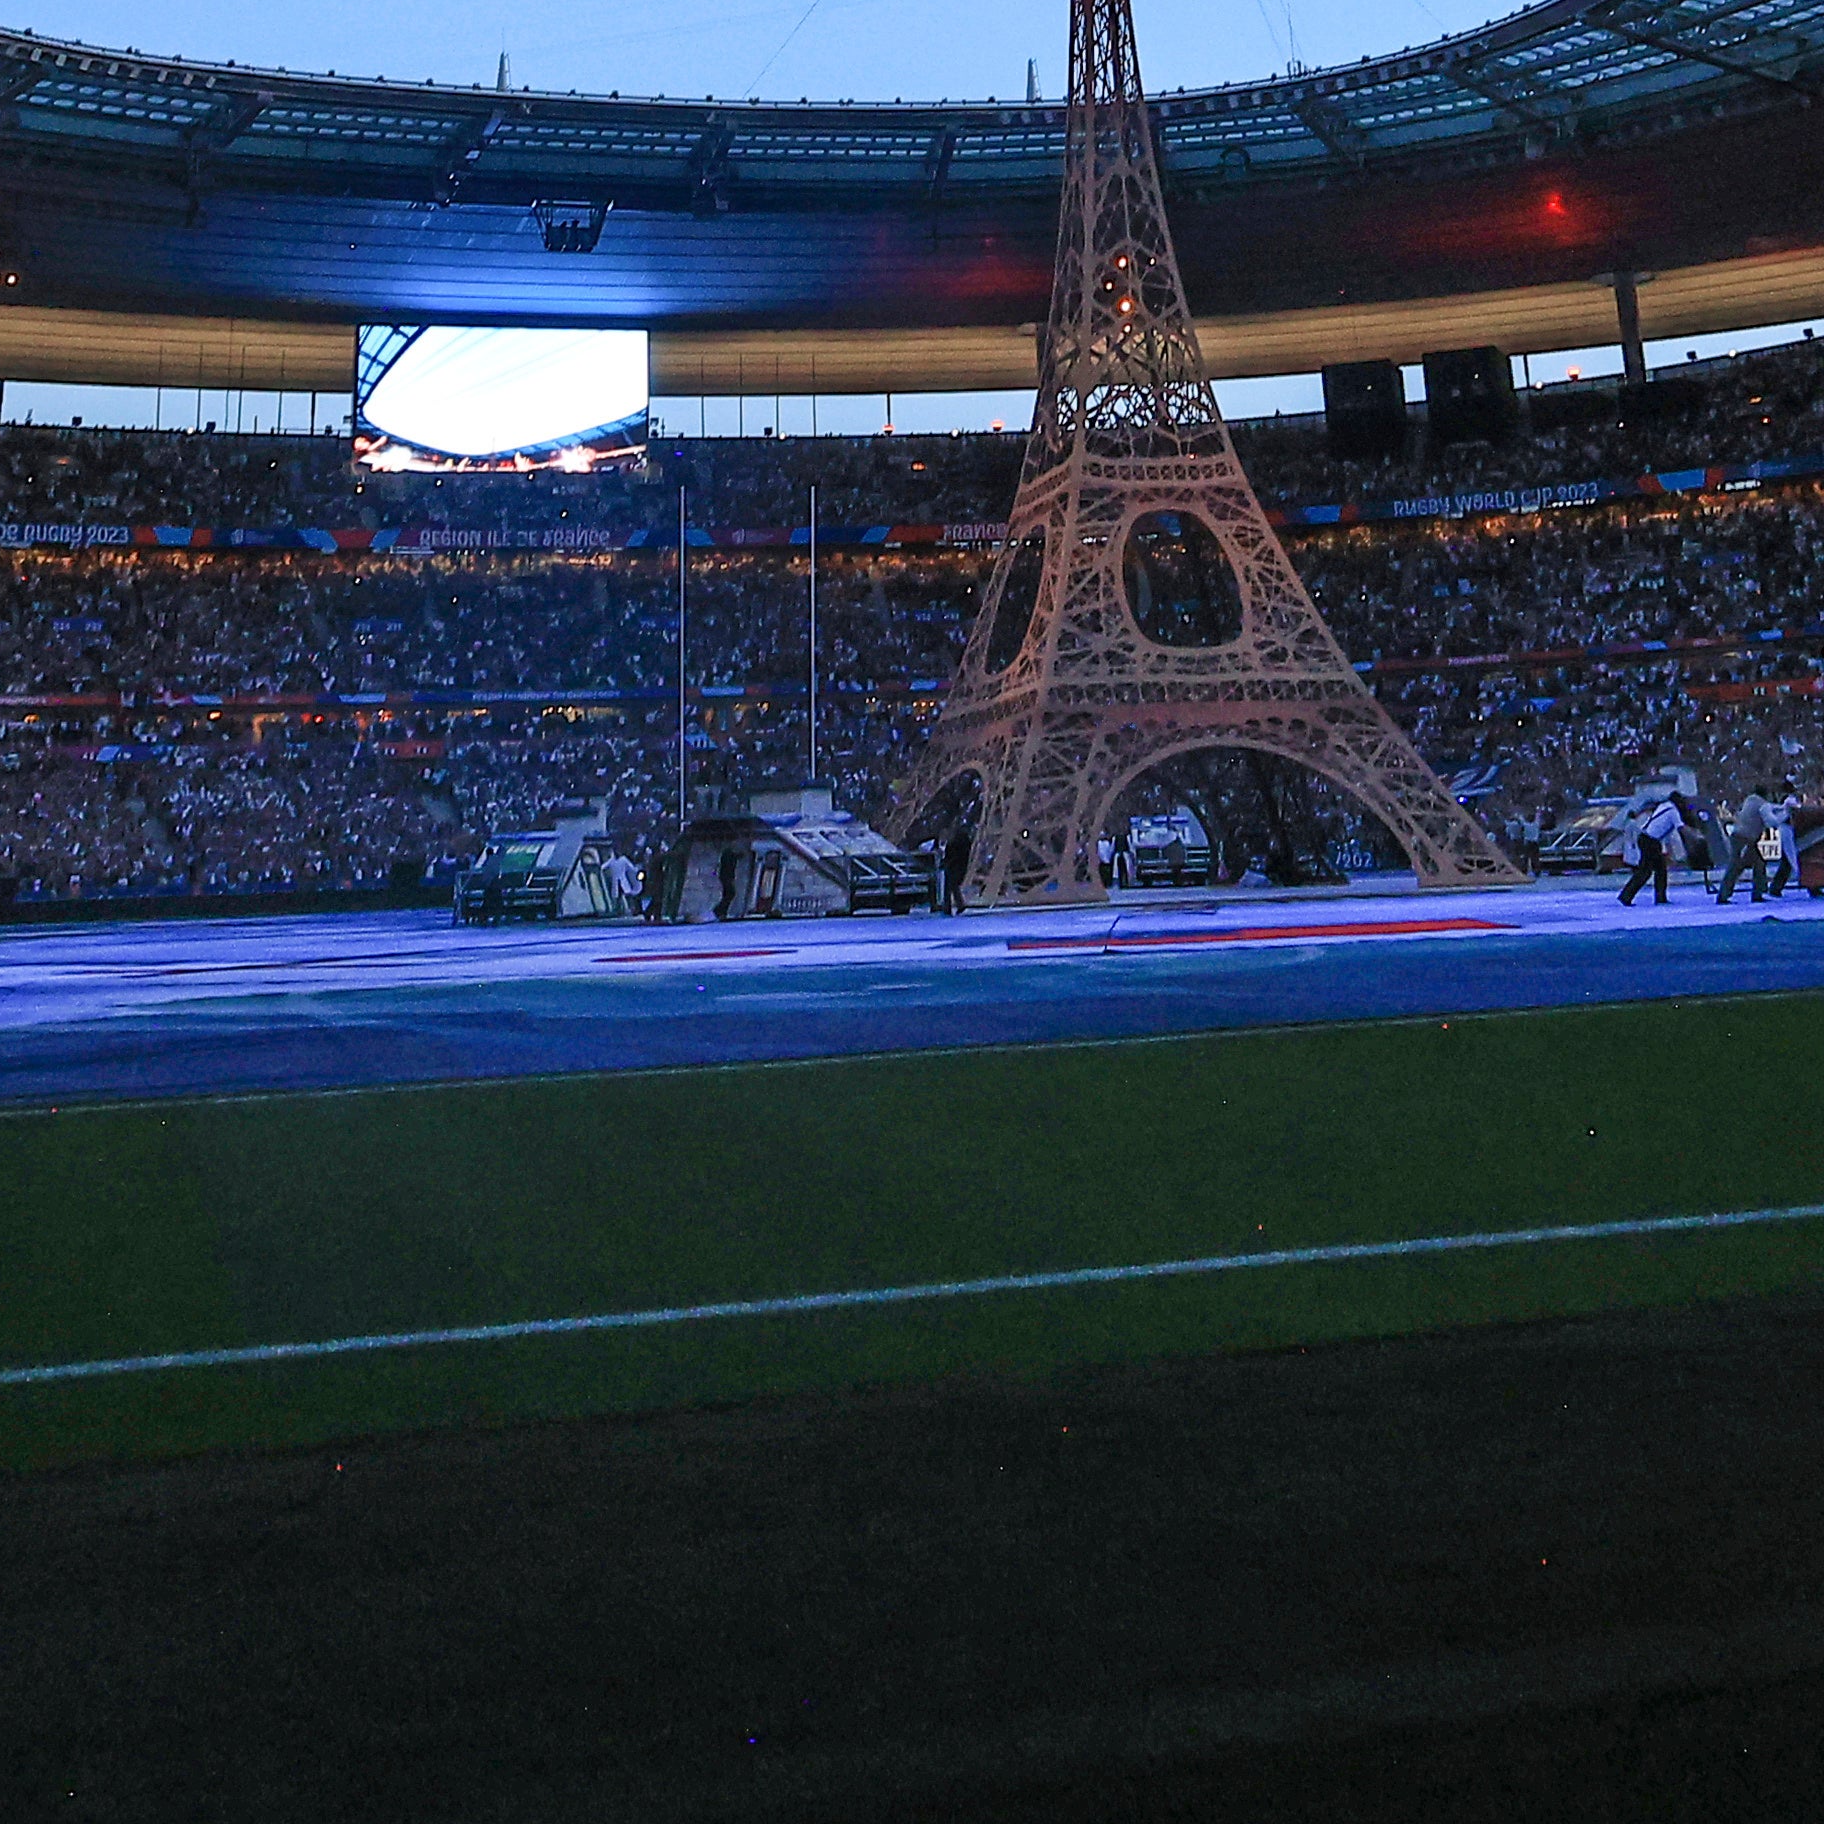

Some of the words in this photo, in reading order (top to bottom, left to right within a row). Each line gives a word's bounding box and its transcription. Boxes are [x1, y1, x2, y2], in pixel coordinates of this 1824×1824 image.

[1393, 495, 1451, 518] RUGBY
[1454, 491, 1515, 512] WORLD
[1520, 486, 1553, 508] CUP
[1556, 481, 1599, 502] 2023
[87, 525, 130, 548] 2023
